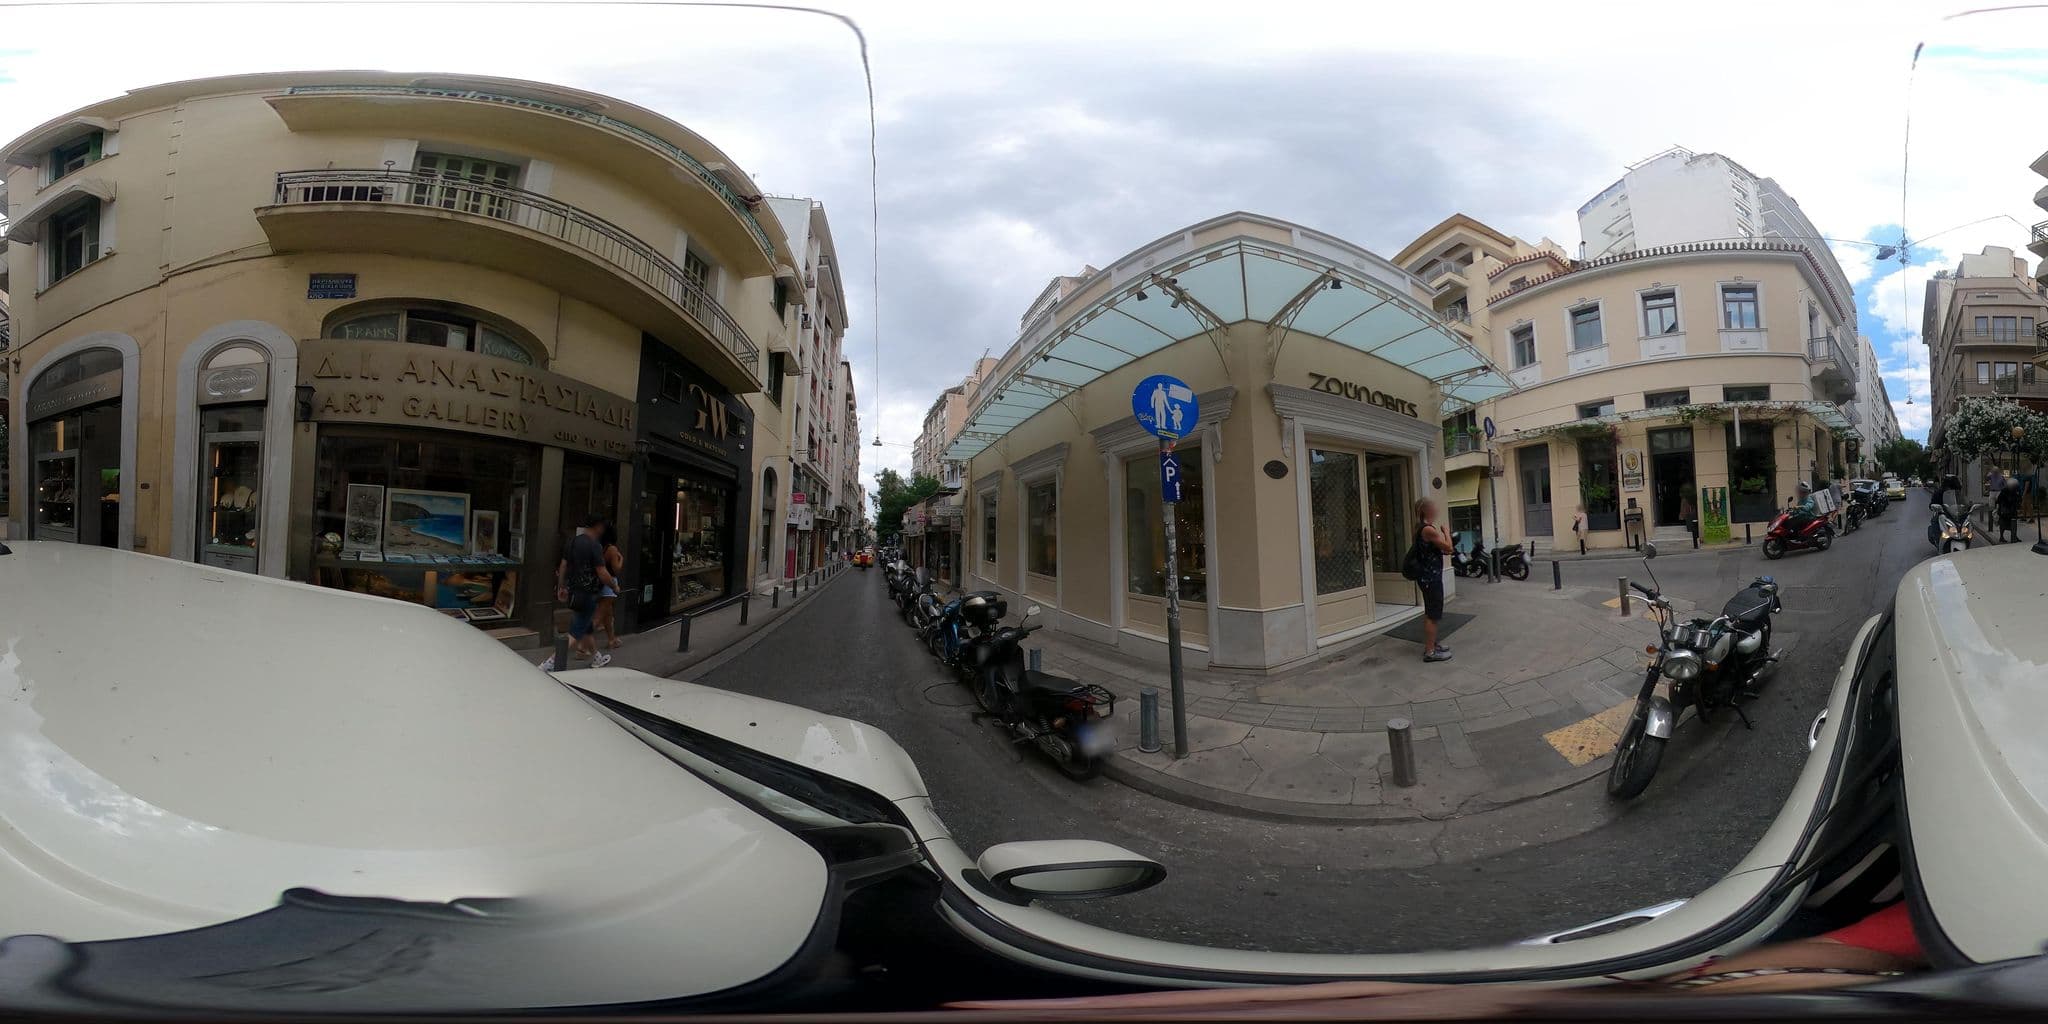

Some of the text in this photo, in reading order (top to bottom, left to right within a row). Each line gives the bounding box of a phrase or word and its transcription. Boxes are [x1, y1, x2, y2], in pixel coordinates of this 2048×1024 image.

[320, 392, 535, 434] ART GALLERY
[397, 359, 633, 431] ΑΝΑΣΤΑΣΙΑΔΗ
[1165, 466, 1176, 482] P
